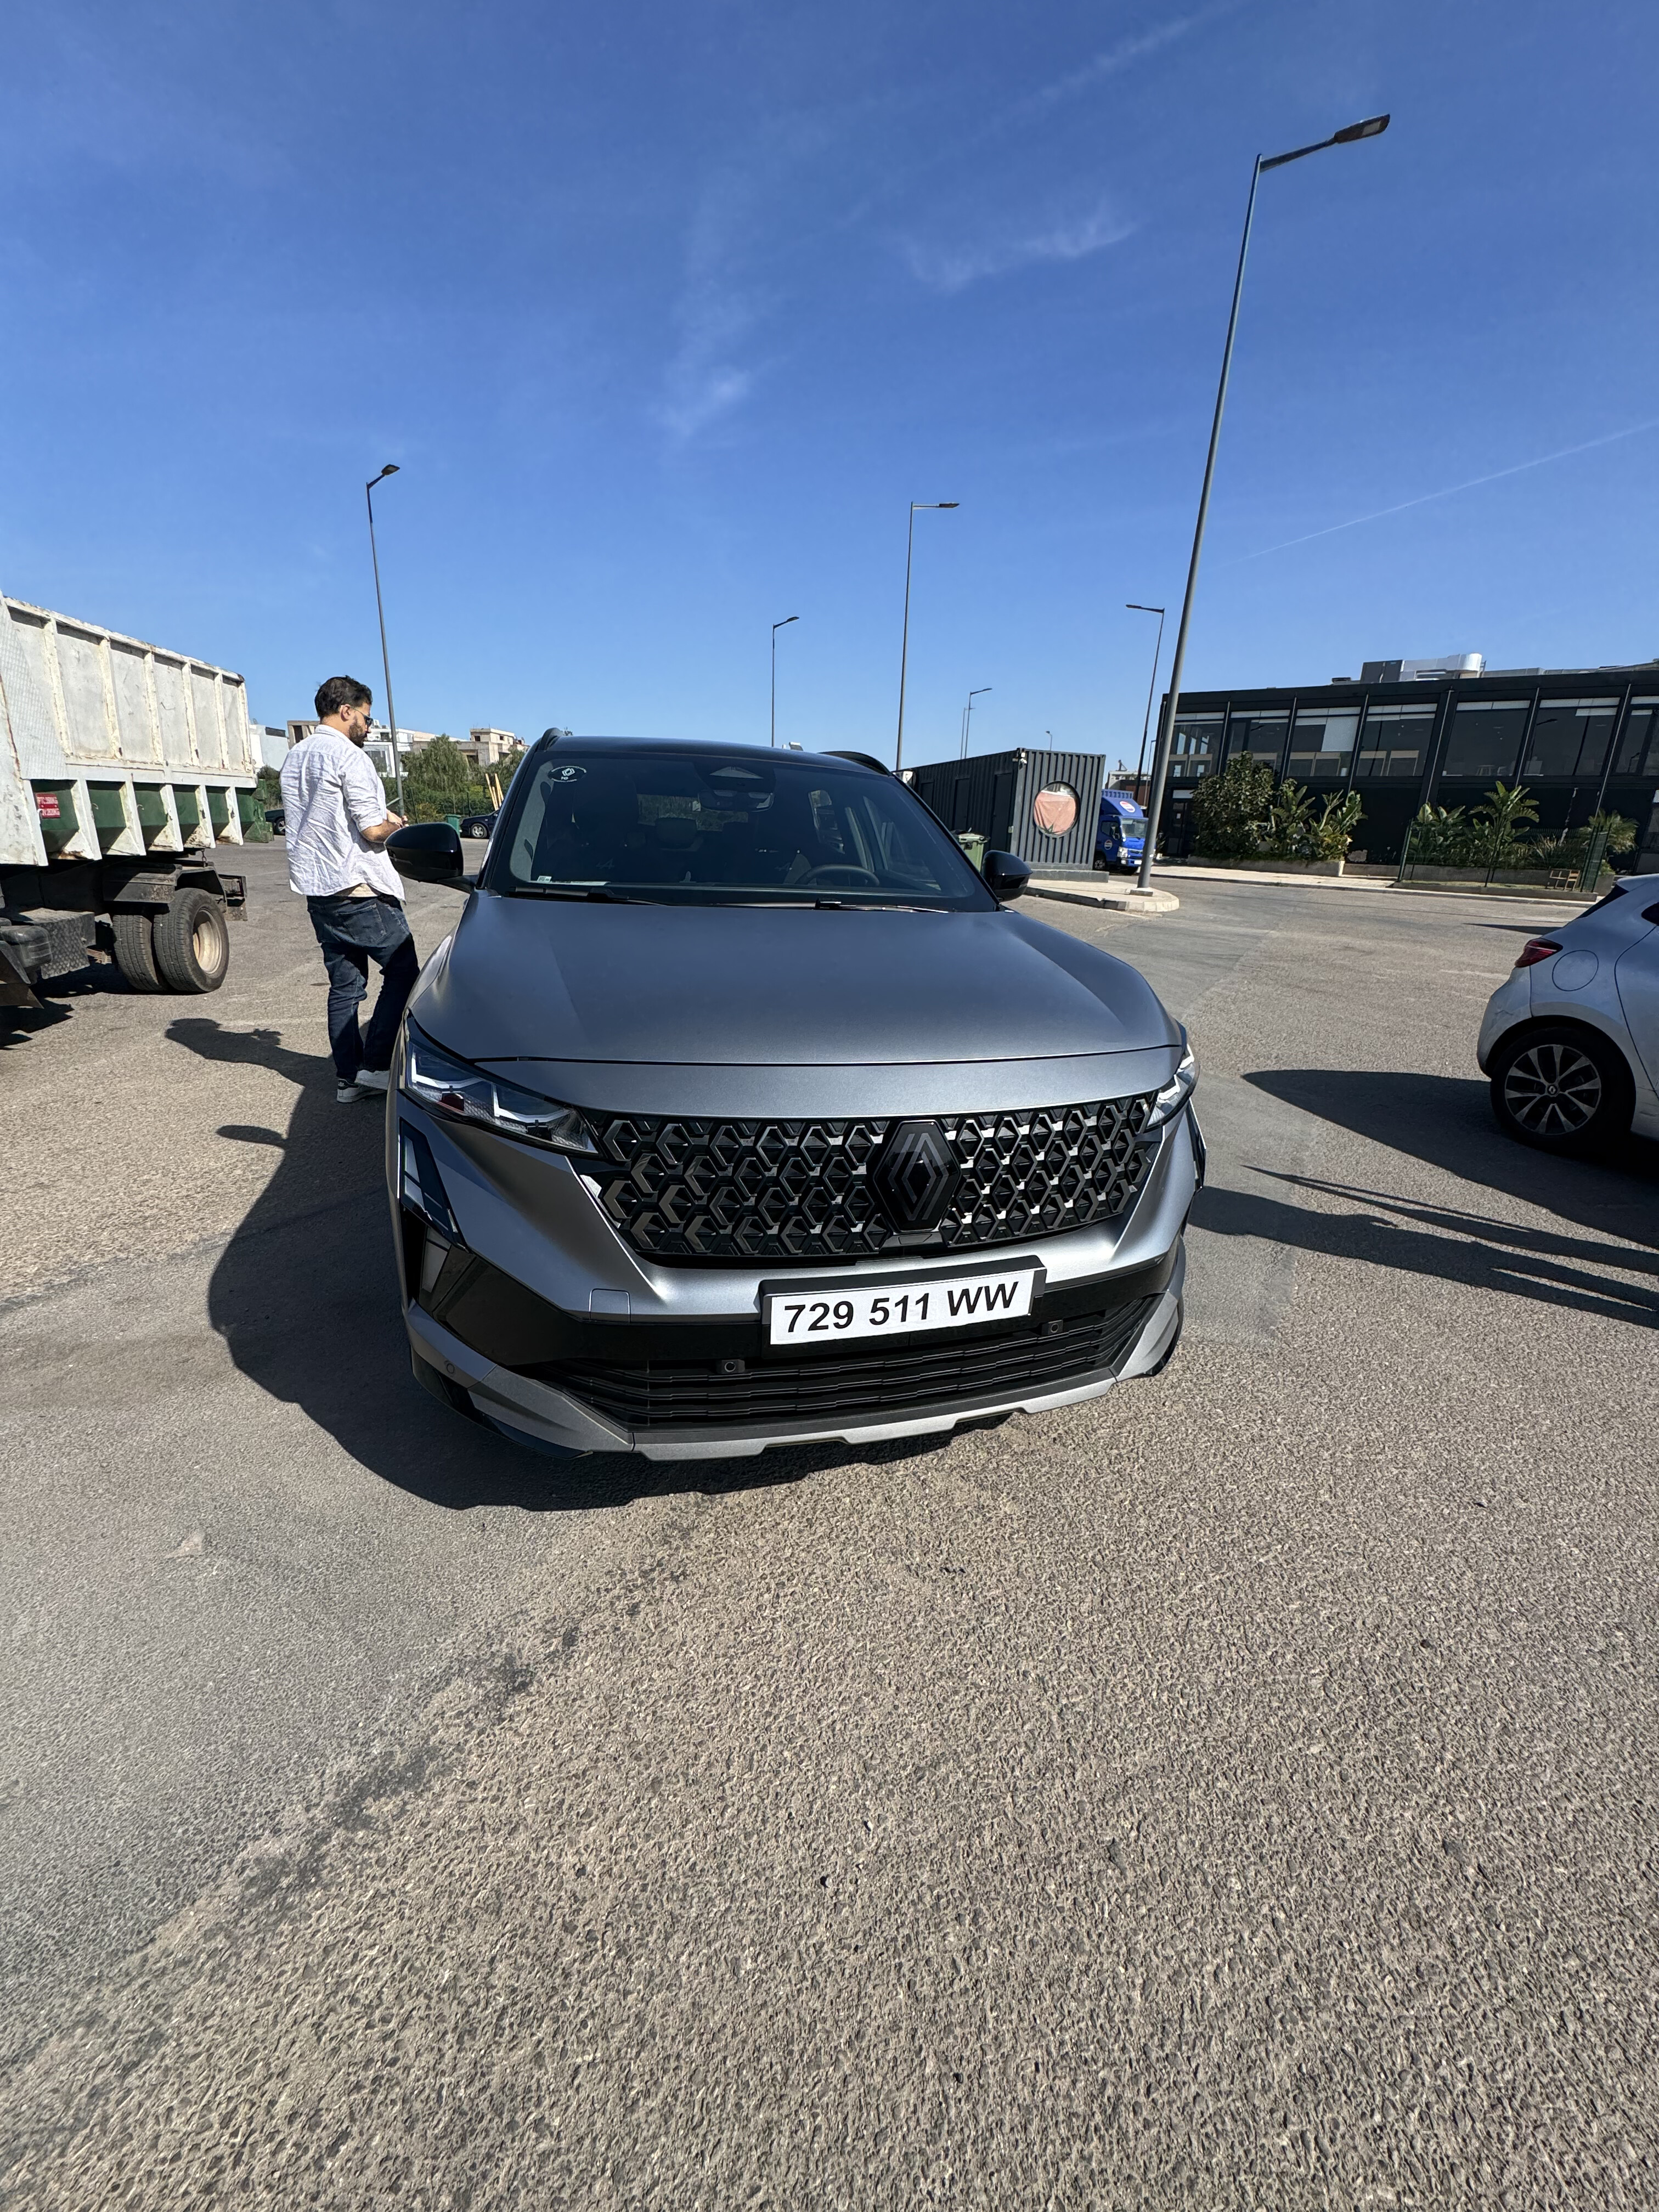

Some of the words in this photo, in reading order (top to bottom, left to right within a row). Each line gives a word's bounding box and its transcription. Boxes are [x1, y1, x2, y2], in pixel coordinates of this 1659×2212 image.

[785, 1301, 854, 1333] 729
[869, 1293, 929, 1325] 511
[947, 1281, 1019, 1317] WW
